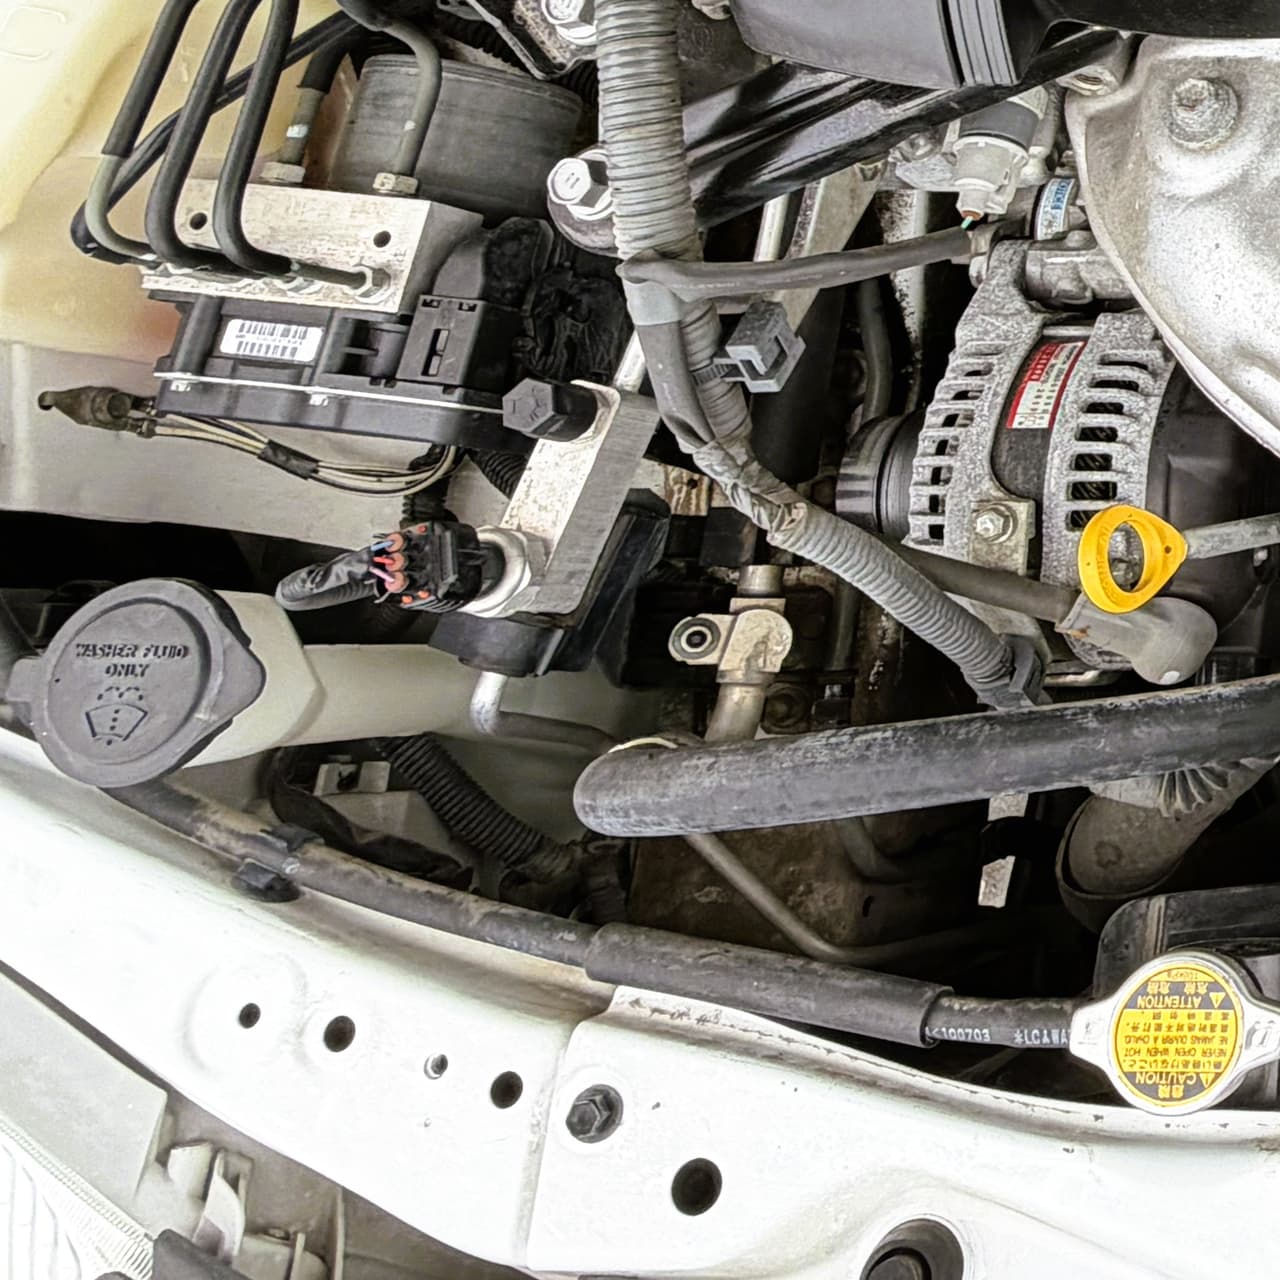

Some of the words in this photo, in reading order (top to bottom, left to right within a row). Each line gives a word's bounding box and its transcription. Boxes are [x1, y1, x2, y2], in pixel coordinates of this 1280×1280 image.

[105, 663, 150, 678] ONLY
[1136, 994, 1202, 1009] ATTENTION
[1190, 1035, 1215, 1045] JAMAIS
[1219, 1035, 1228, 1045] NE
[1124, 1048, 1140, 1058] HOT
[1146, 1048, 1170, 1058] WHEN
[1174, 1048, 1197, 1058] OPEN
[1201, 1048, 1227, 1058] NEVER
[1135, 1072, 1197, 1085] CAUTION
